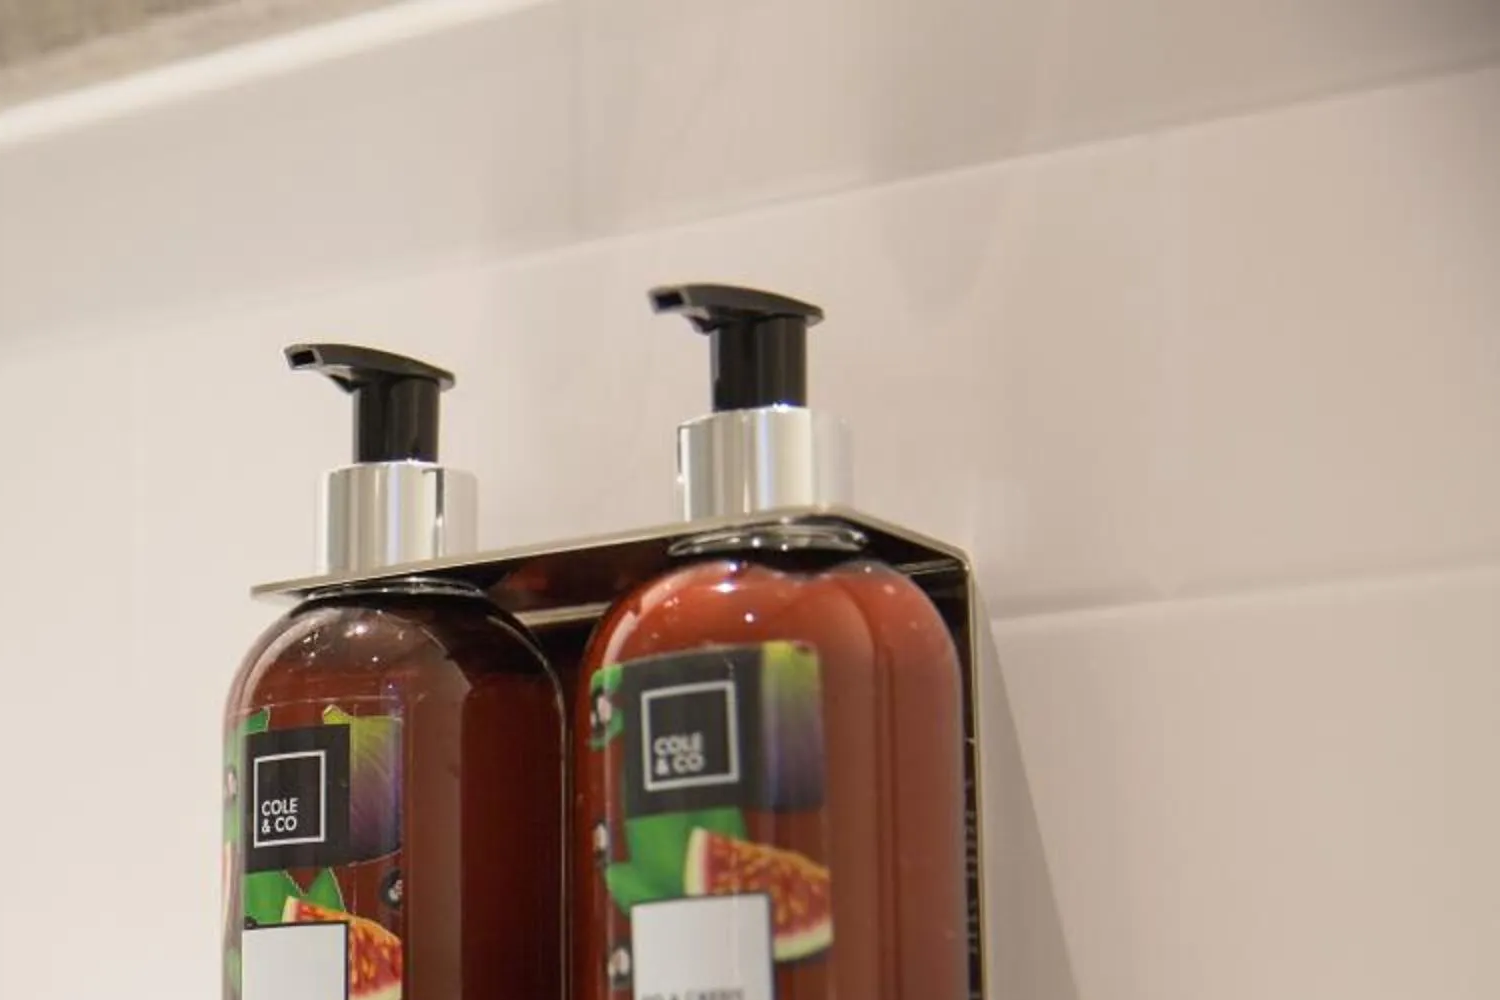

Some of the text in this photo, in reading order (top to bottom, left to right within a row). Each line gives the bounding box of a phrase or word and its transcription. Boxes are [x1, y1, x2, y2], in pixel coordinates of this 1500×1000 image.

[261, 798, 299, 816] COLE
[261, 816, 297, 834] & CO
